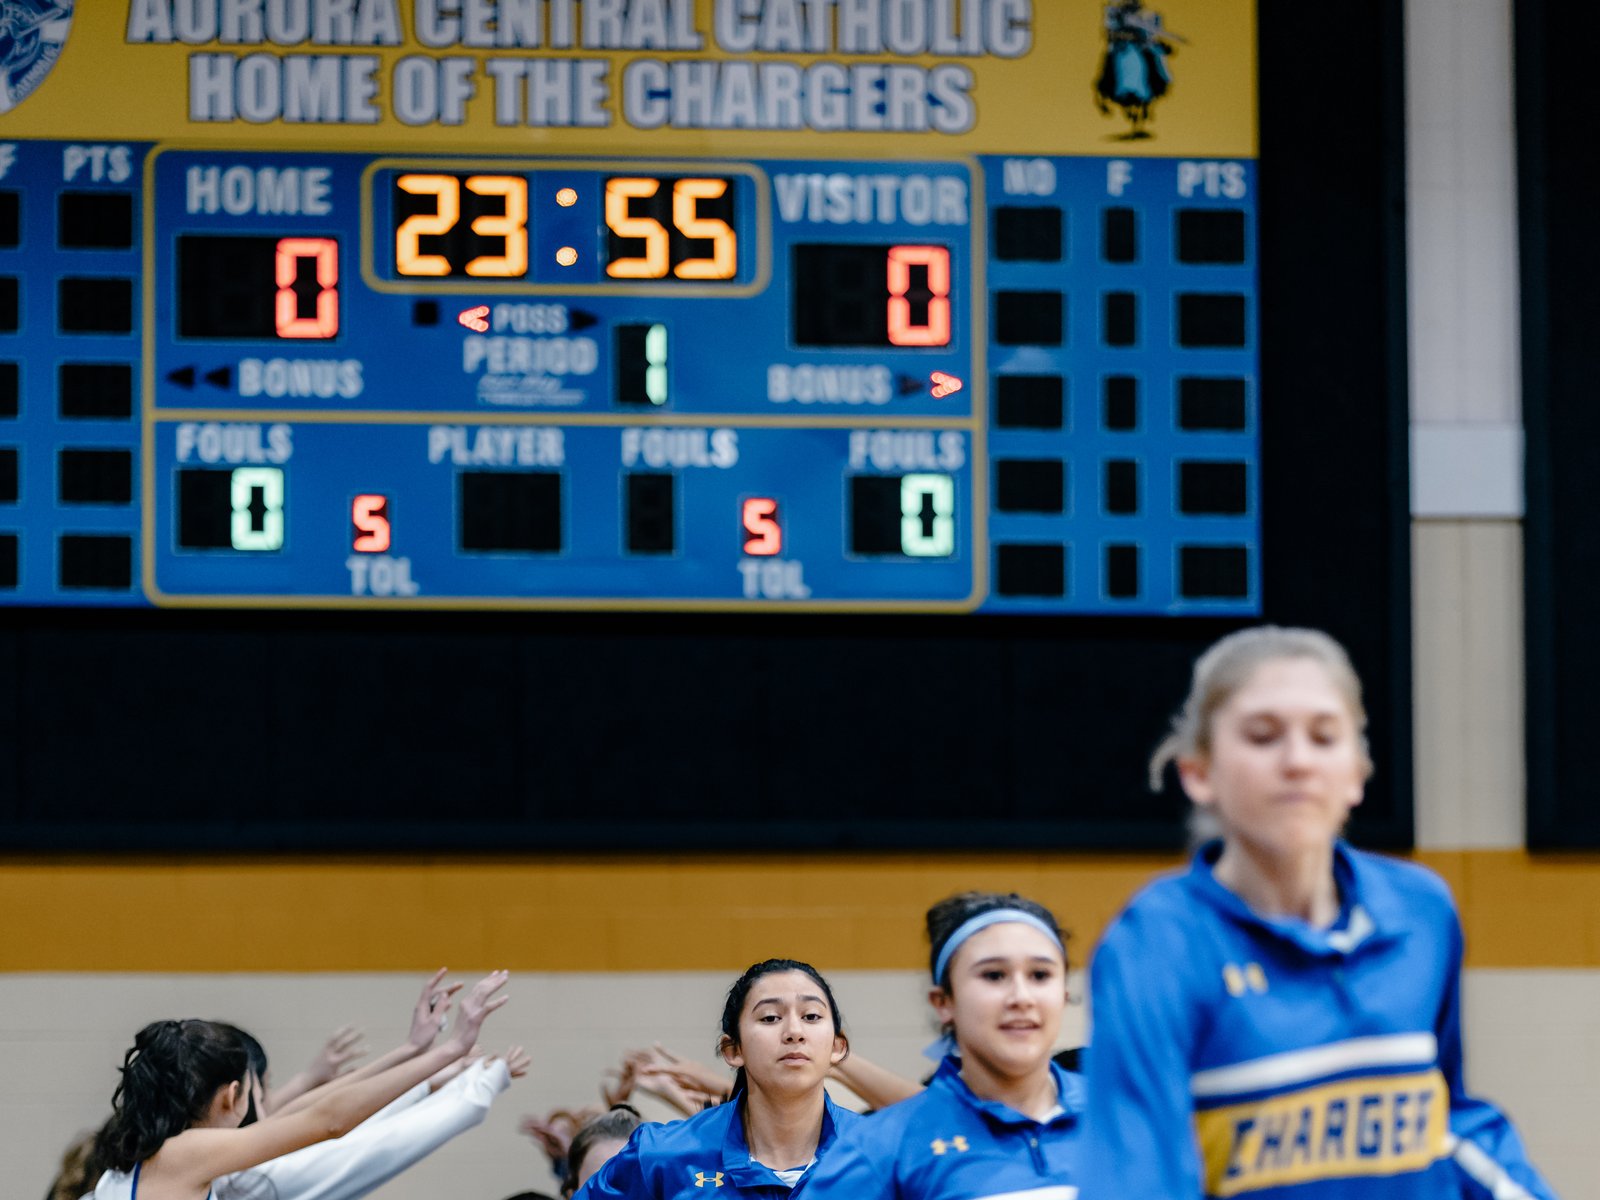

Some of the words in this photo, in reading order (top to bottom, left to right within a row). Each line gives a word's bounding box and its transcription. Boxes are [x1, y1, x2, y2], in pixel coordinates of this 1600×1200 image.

[127, 0, 402, 44] AURORA
[415, 0, 704, 51] CENTRAL
[714, 0, 1033, 57] CATHOLIC
[188, 53, 382, 123] HOME
[393, 56, 475, 125] OF
[487, 58, 612, 127] THE
[623, 60, 977, 133] CHARGERS
[63, 145, 132, 182] PTS
[1003, 159, 1056, 196] NO
[1107, 161, 1132, 197] F
[1177, 161, 1246, 199] PTS
[186, 166, 332, 215] HOME
[775, 173, 969, 225] VISITOR
[396, 174, 737, 280] 23:55
[276, 238, 339, 339] 0
[887, 245, 951, 347] 0
[493, 303, 567, 333] POSS
[463, 335, 597, 375] PERIOD
[645, 323, 668, 405] 1
[238, 359, 364, 399] BONUS
[767, 365, 892, 404] BONUS
[176, 424, 292, 464] FOULS
[429, 426, 566, 466] PLAYER
[621, 428, 739, 468] FOULS
[849, 430, 965, 470] FOULS
[231, 467, 284, 551] 0
[901, 473, 954, 557] 0
[347, 556, 419, 597] TOL
[738, 559, 811, 599] TOL
